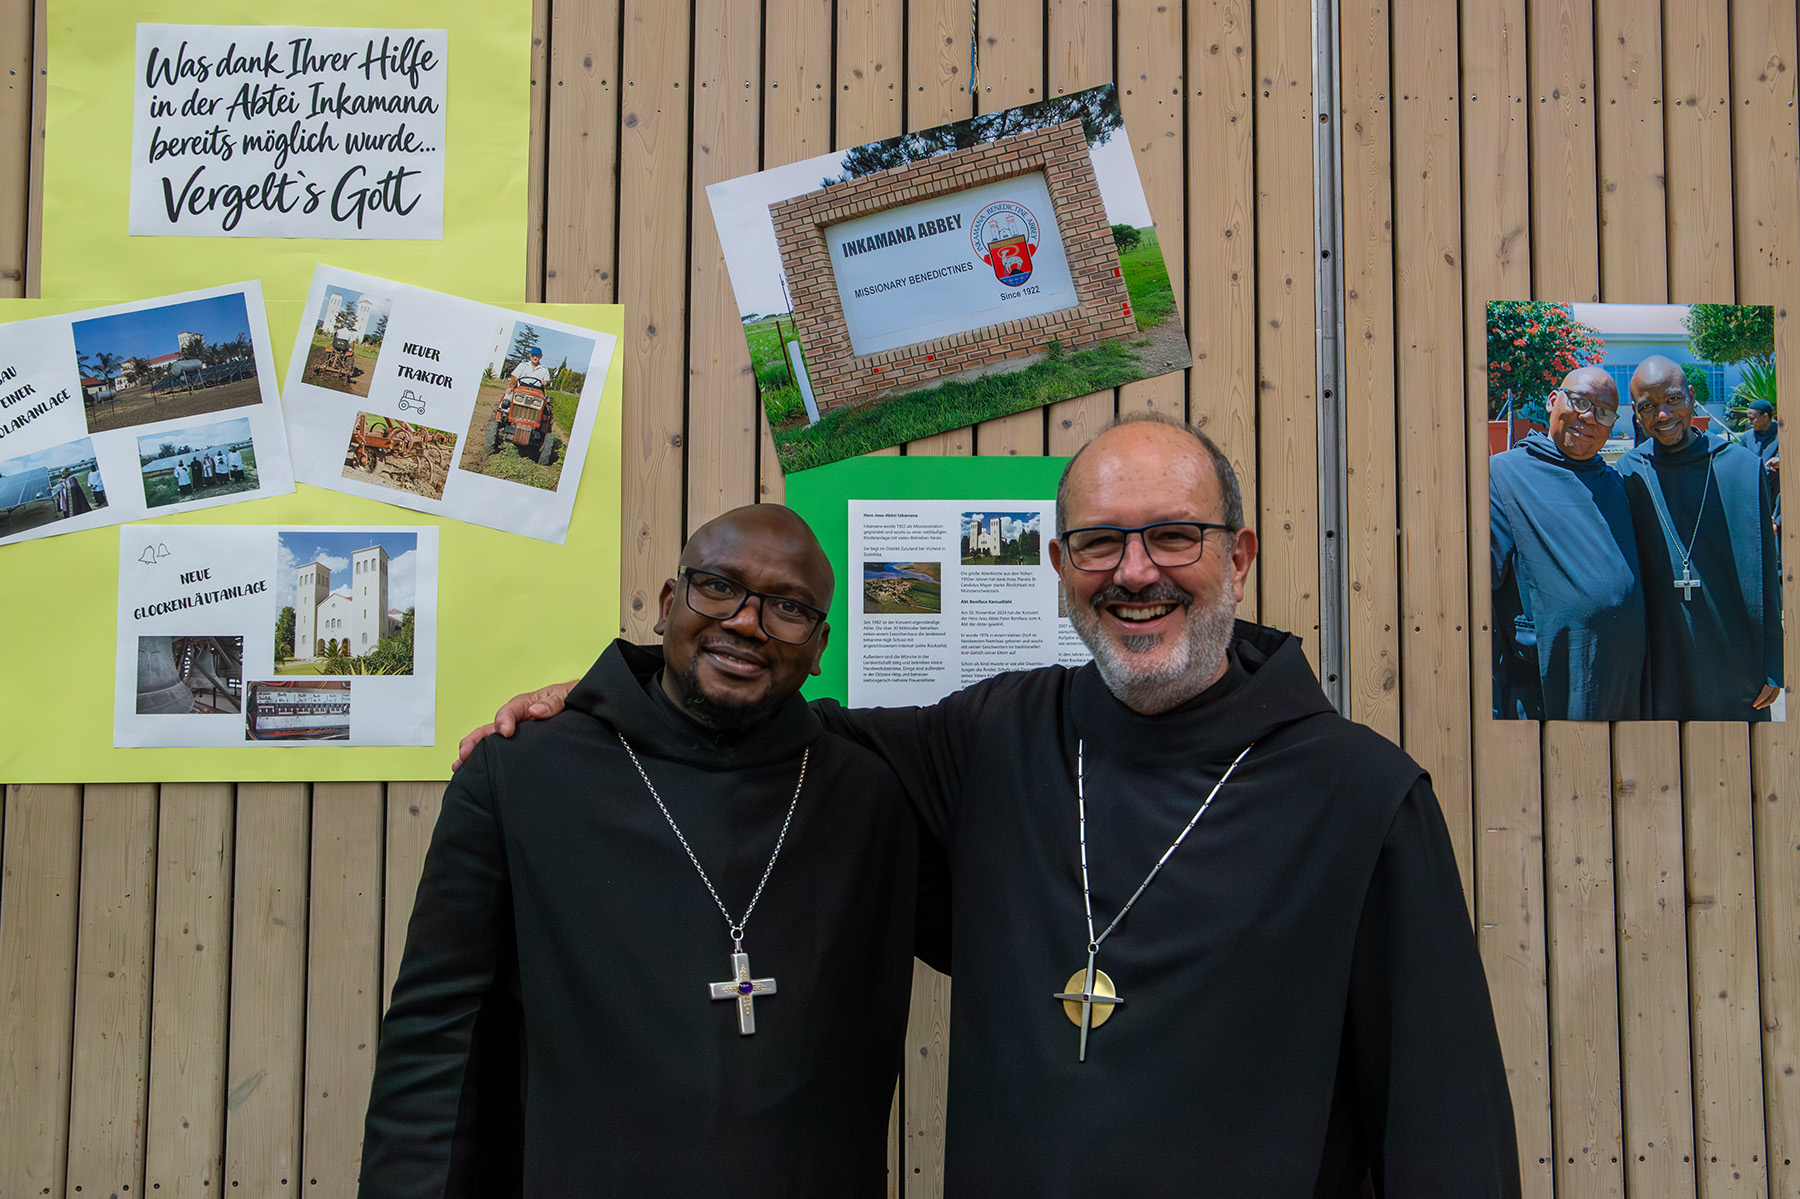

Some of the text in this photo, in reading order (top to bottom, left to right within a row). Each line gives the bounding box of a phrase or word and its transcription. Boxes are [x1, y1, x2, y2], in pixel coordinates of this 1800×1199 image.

[146, 36, 439, 89] Was dank Ihrer Hilfe
[150, 82, 439, 122] in der Abtei Inkamana
[149, 120, 436, 169] bereits möglich wurde...
[330, 165, 422, 230] Gott
[842, 213, 963, 258] INKAMANA ABBEY
[986, 203, 1028, 217] BENEDICTINE
[1027, 218, 1037, 240] ABBEY
[854, 261, 974, 299] MISSIONARY BENEDICTINES
[1000, 285, 1040, 301] Since 1922
[403, 342, 440, 362] NEUER
[0, 366, 17, 385] AU
[398, 365, 453, 389] TRAKTOR
[0, 384, 36, 409] EINER
[0, 388, 71, 438] OLARANLAGE
[180, 568, 212, 585] NEUE
[133, 580, 267, 620] GLOCKENLÄUTANLAGE
